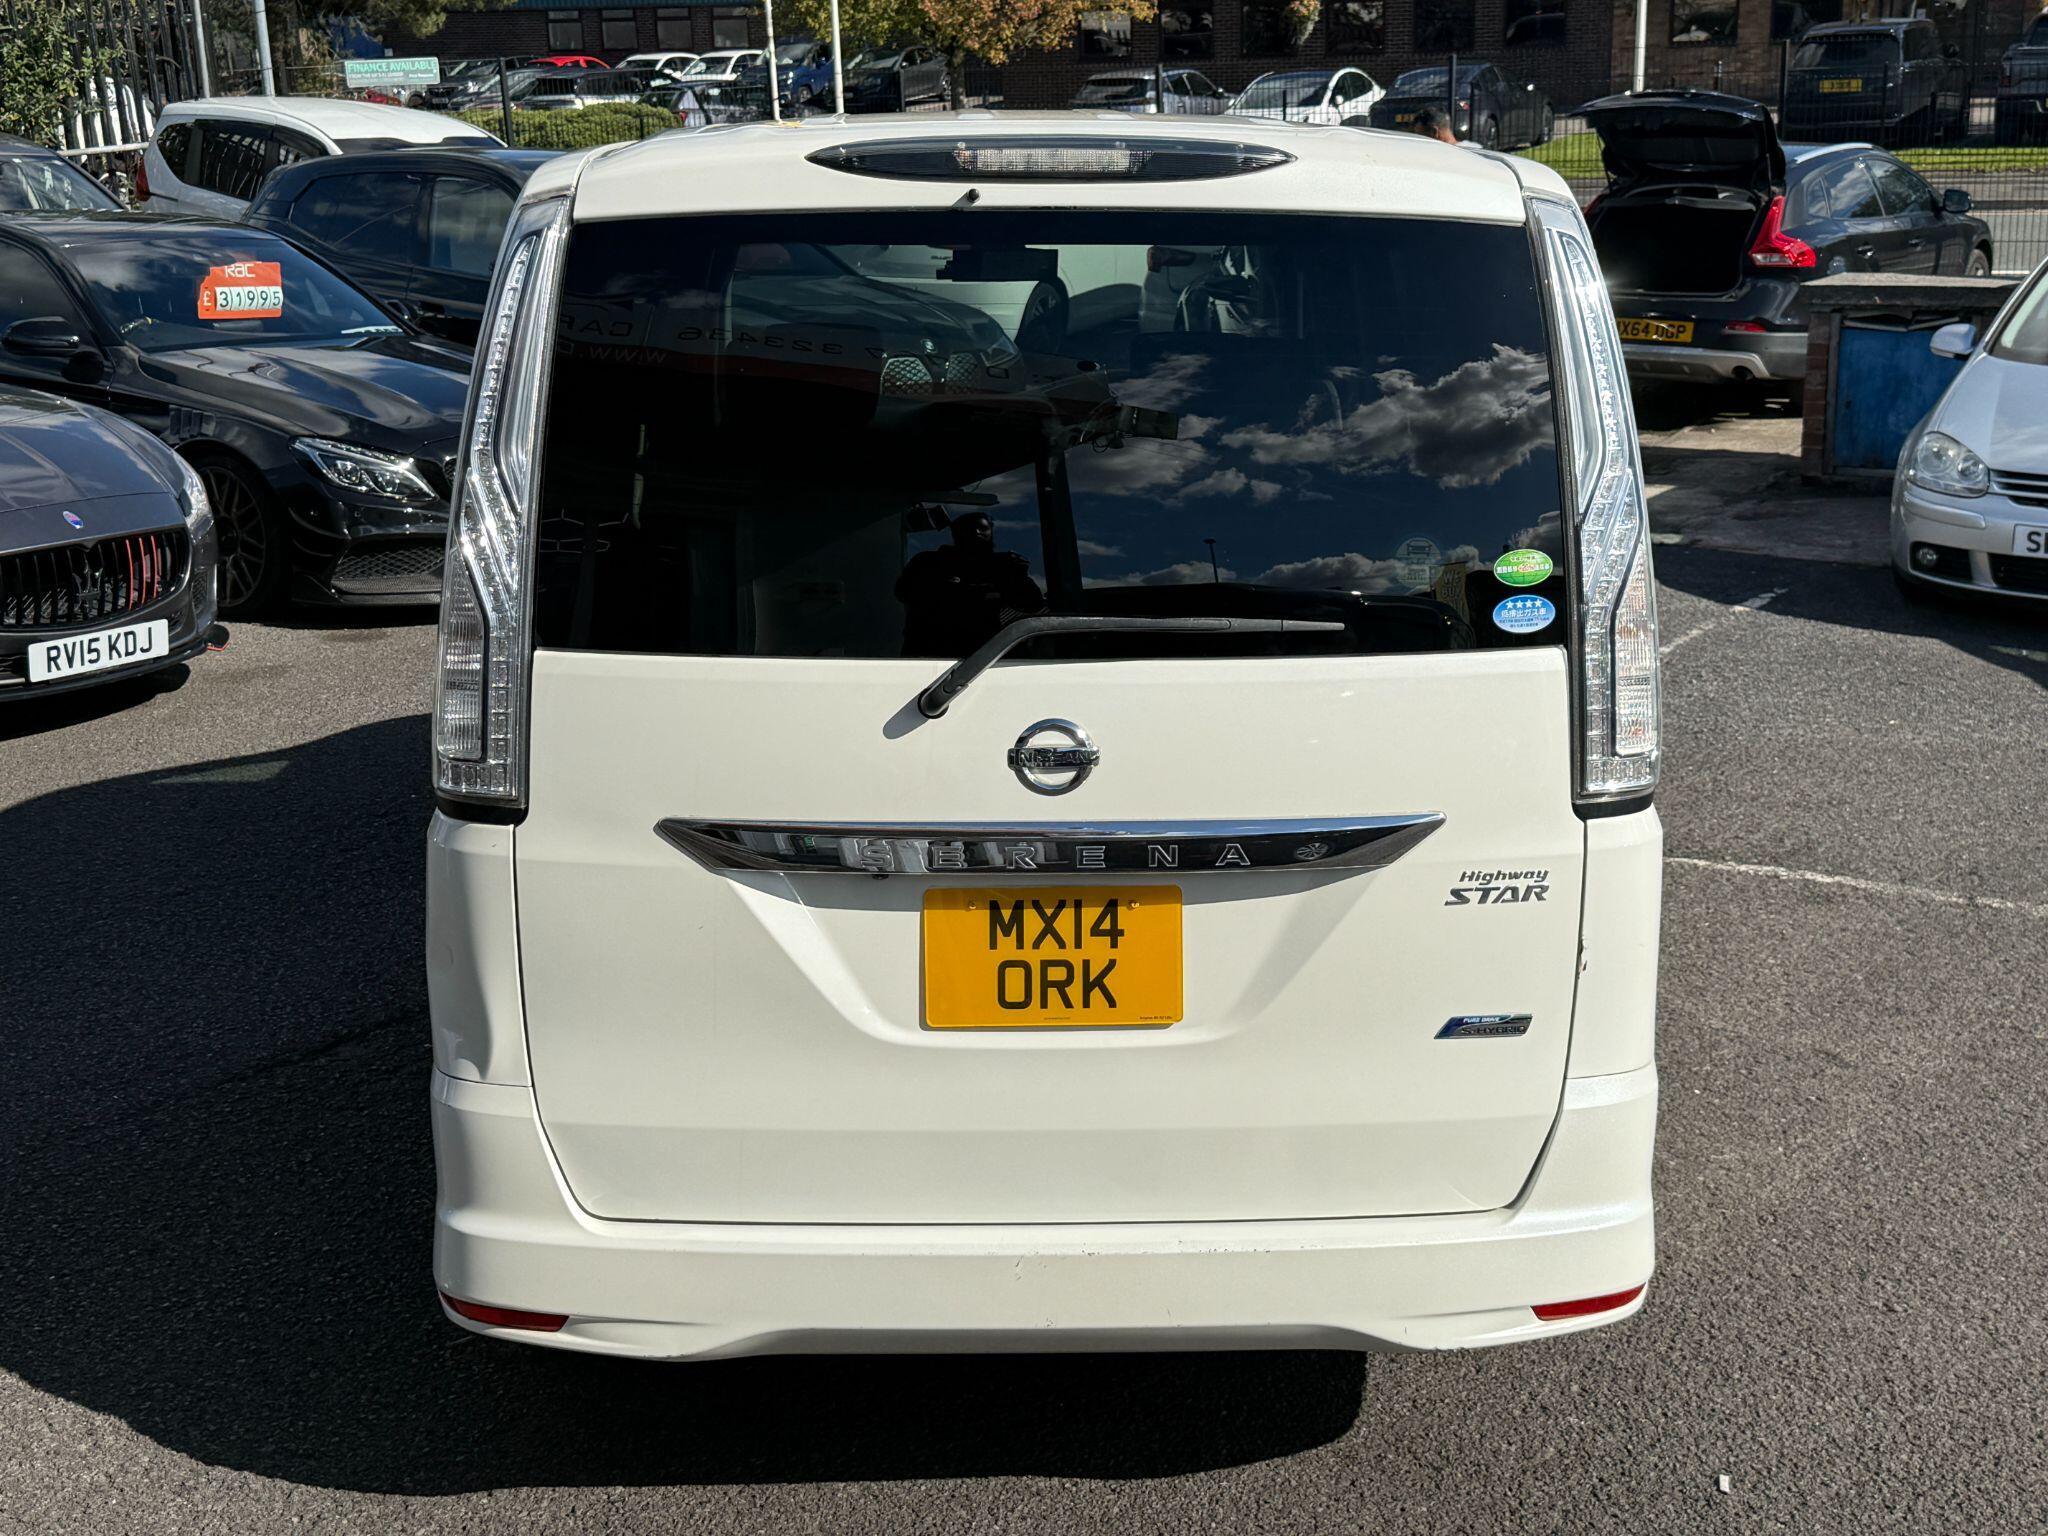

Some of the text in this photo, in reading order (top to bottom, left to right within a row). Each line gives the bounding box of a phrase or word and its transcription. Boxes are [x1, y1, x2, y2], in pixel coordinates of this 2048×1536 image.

[348, 60, 437, 73] FINANCE AVAILABLE
[1617, 320, 1651, 337] X64
[2026, 530, 2048, 555] S
[46, 626, 153, 673] RV15 KDJ
[861, 843, 1252, 869] SERENA
[1459, 869, 1549, 886] Highway
[1444, 884, 1550, 906] STAR
[989, 898, 1125, 950] MX14
[997, 958, 1118, 1009] ORK
